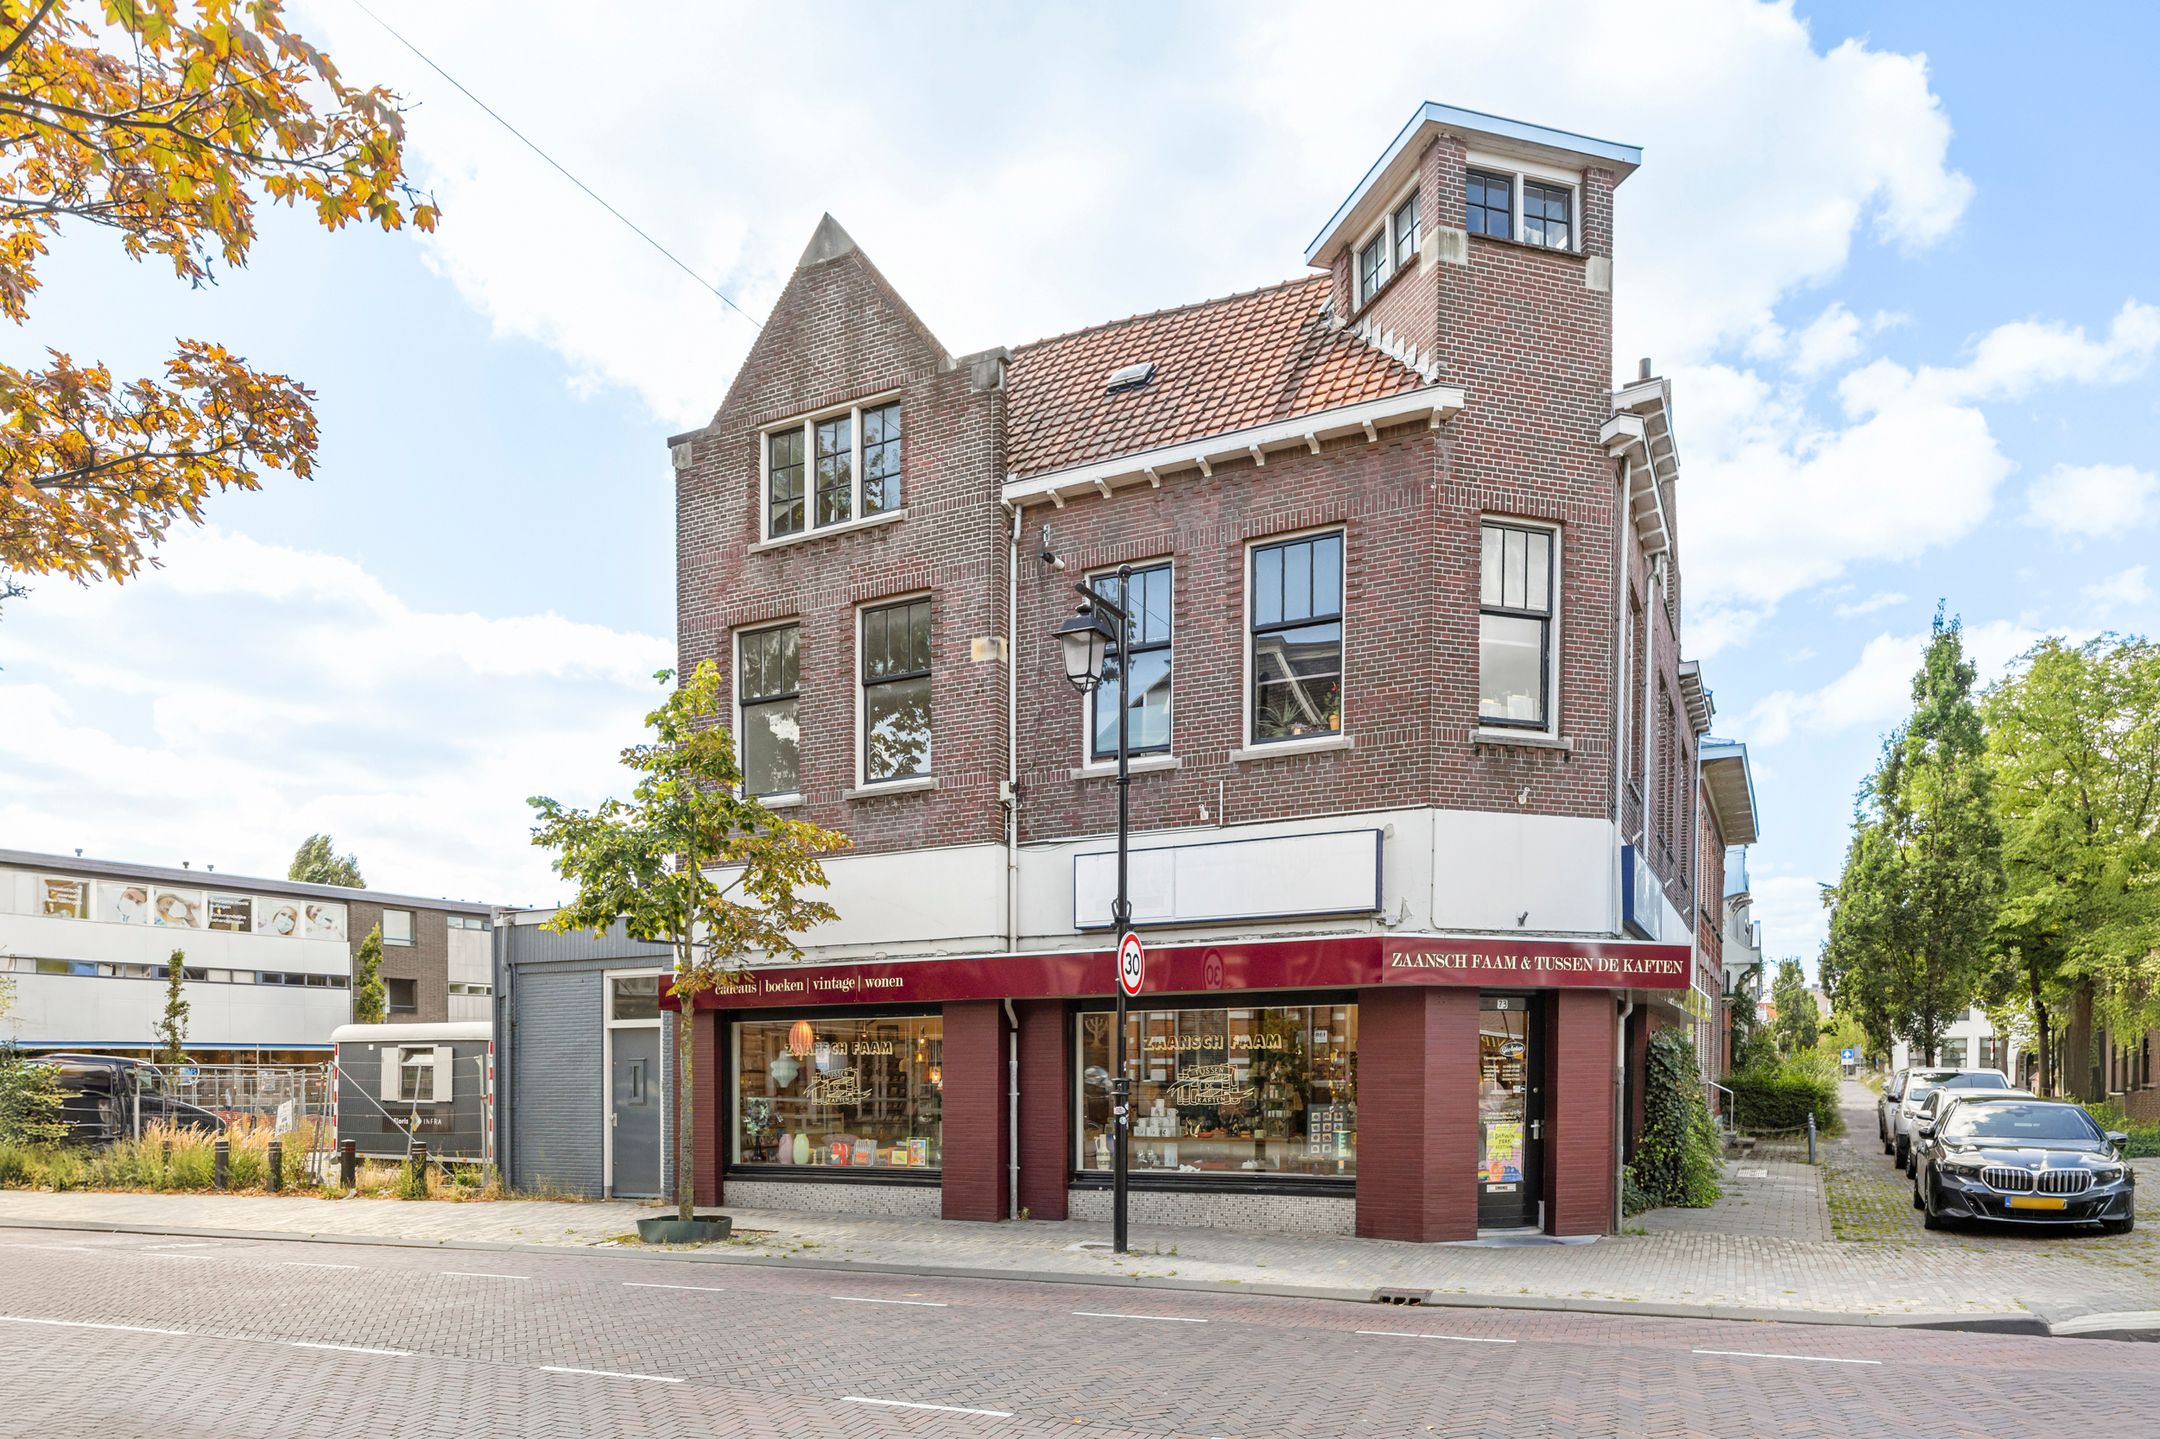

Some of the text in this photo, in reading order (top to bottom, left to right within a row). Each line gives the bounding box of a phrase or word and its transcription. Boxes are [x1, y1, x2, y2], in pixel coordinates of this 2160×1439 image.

[1125, 952, 1140, 976] 30
[1391, 952, 1684, 975] ZAANSCH FAAM & TUSSEN DE KAFTEN
[714, 976, 904, 995] cadeaus boeken vintage wonen
[1497, 1000, 1508, 1009] 73
[852, 1041, 893, 1055] FAAM
[1143, 1034, 1282, 1050] ZAANSCH FAAM
